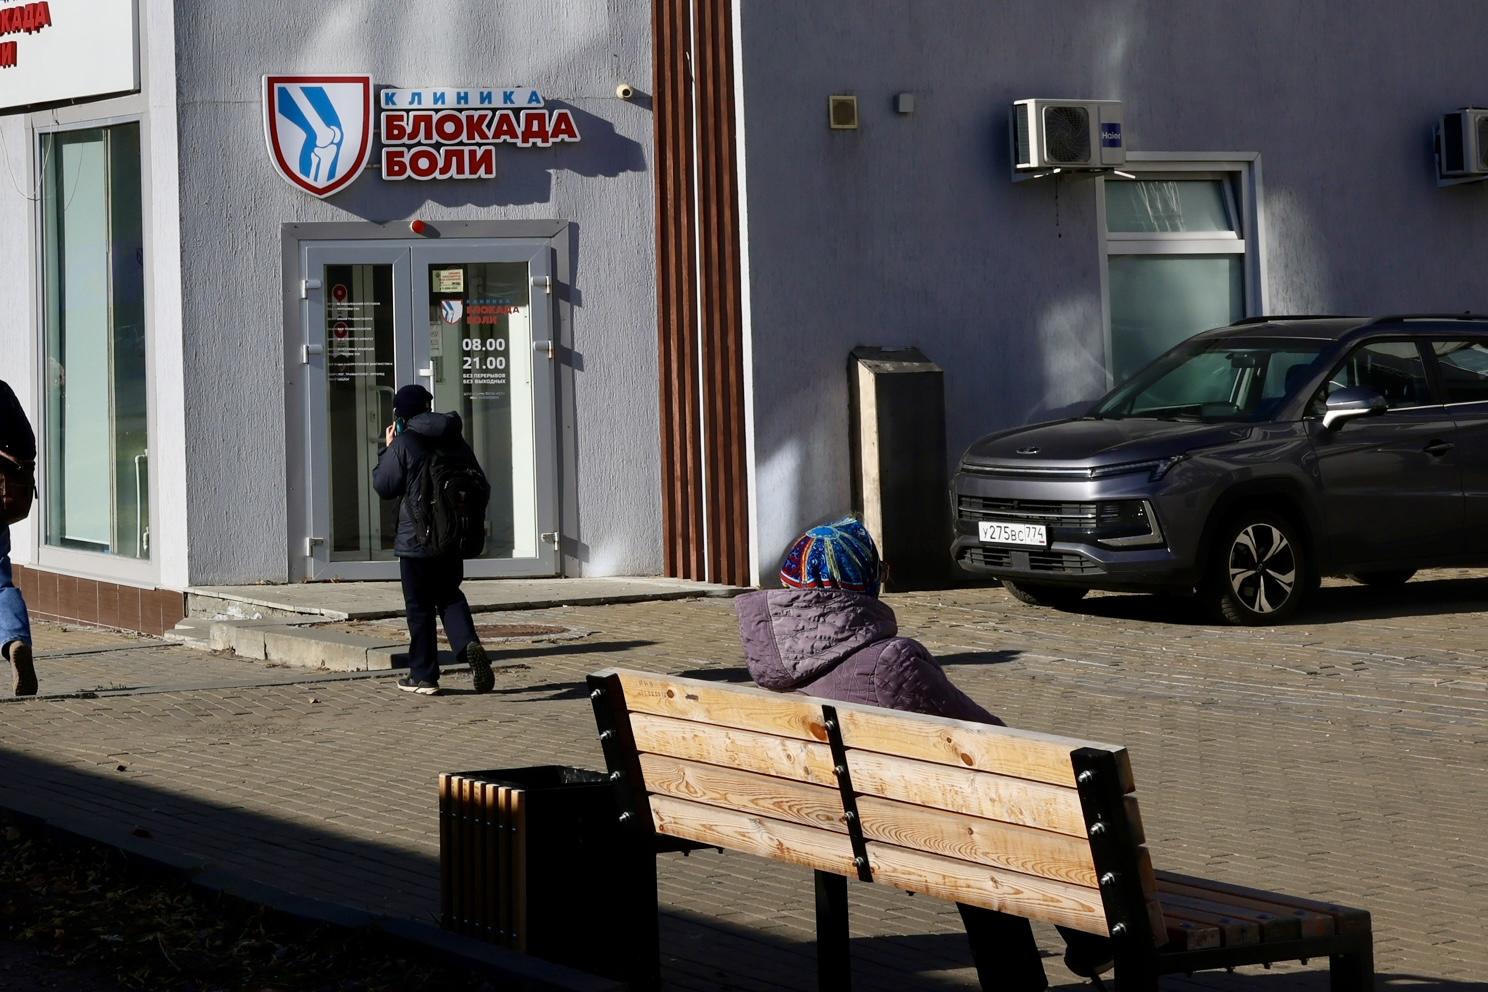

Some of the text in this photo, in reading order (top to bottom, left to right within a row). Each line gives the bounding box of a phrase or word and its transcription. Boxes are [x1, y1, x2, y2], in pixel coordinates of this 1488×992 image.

[384, 90, 542, 106] КЛИНИКА
[384, 111, 579, 145] БЛОКАДА
[1102, 131, 1121, 139] Haier
[384, 148, 494, 178] БОЛИ
[462, 338, 506, 351] 08.00
[462, 356, 506, 369] 21.00
[982, 525, 1044, 541] У275ВС 774
